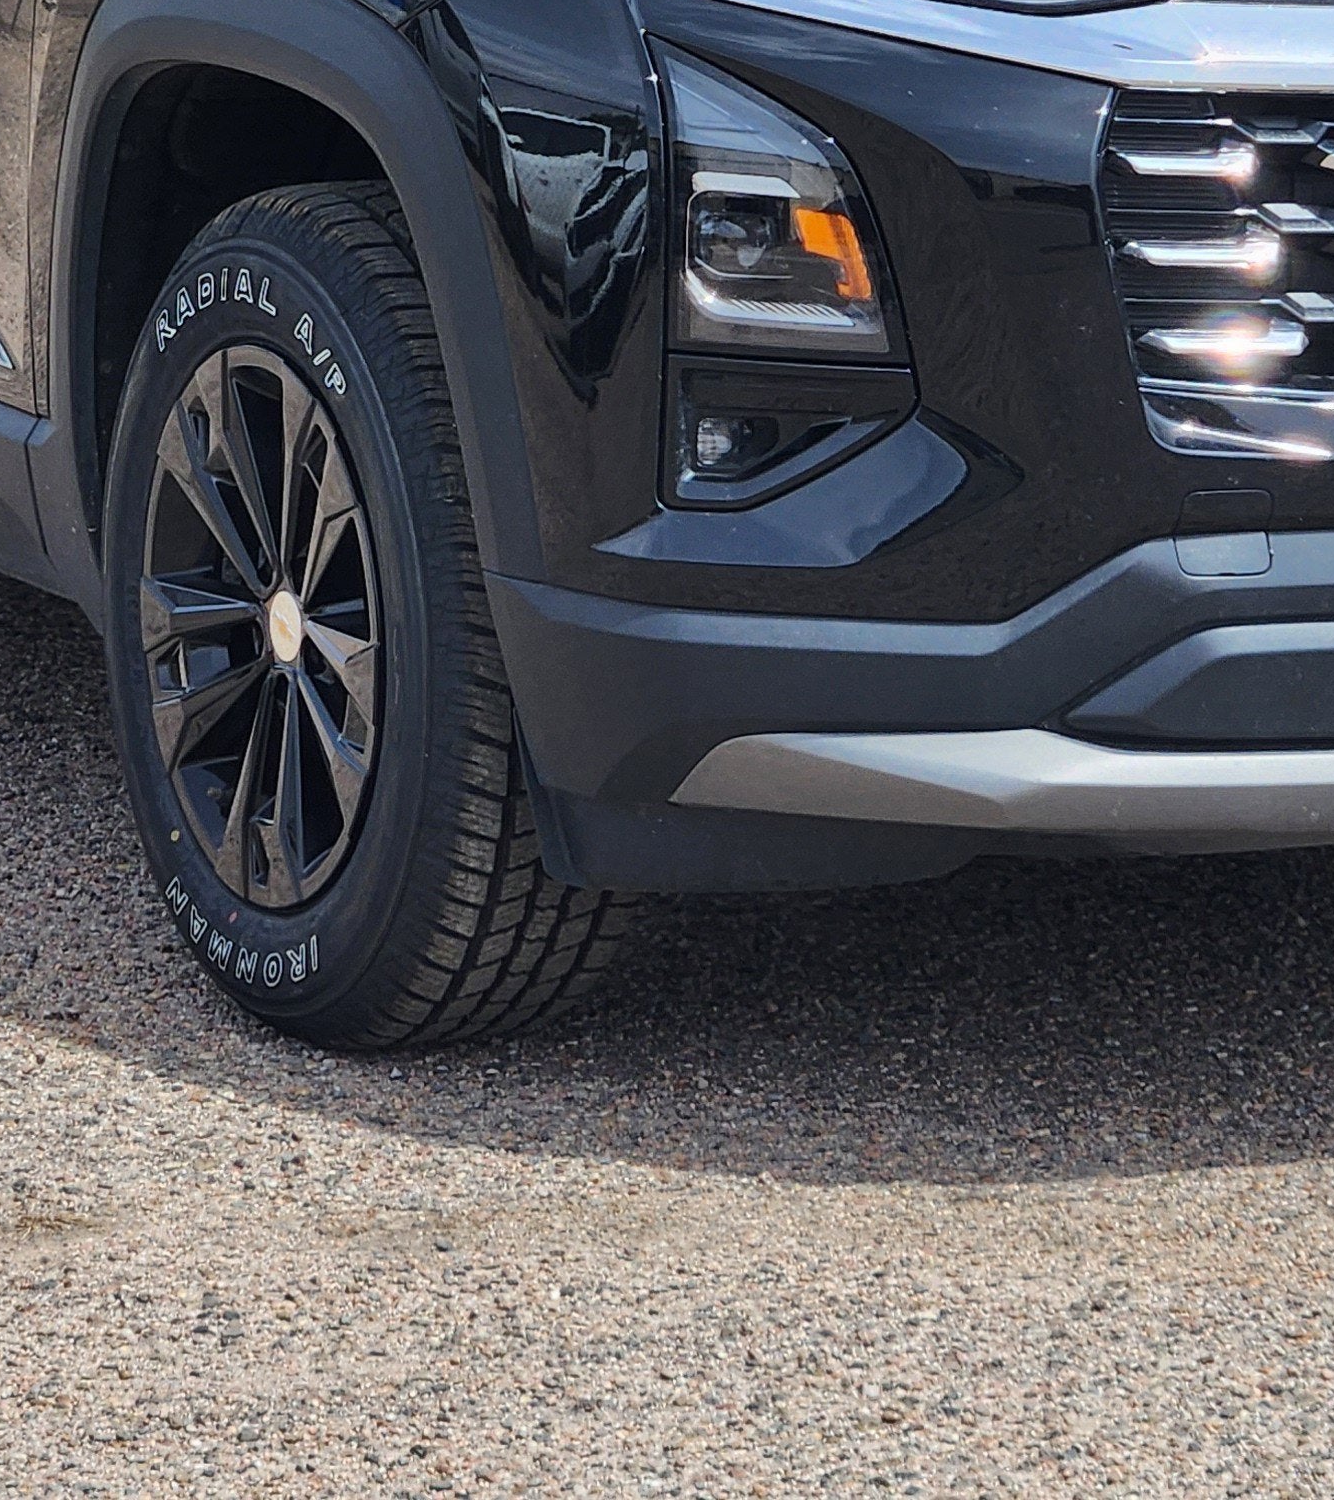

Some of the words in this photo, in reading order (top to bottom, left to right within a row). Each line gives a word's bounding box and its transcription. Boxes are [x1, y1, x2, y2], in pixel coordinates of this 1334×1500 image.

[155, 268, 276, 352] RADIAL
[294, 313, 347, 395] A/P
[165, 876, 318, 988] IRONMAN
